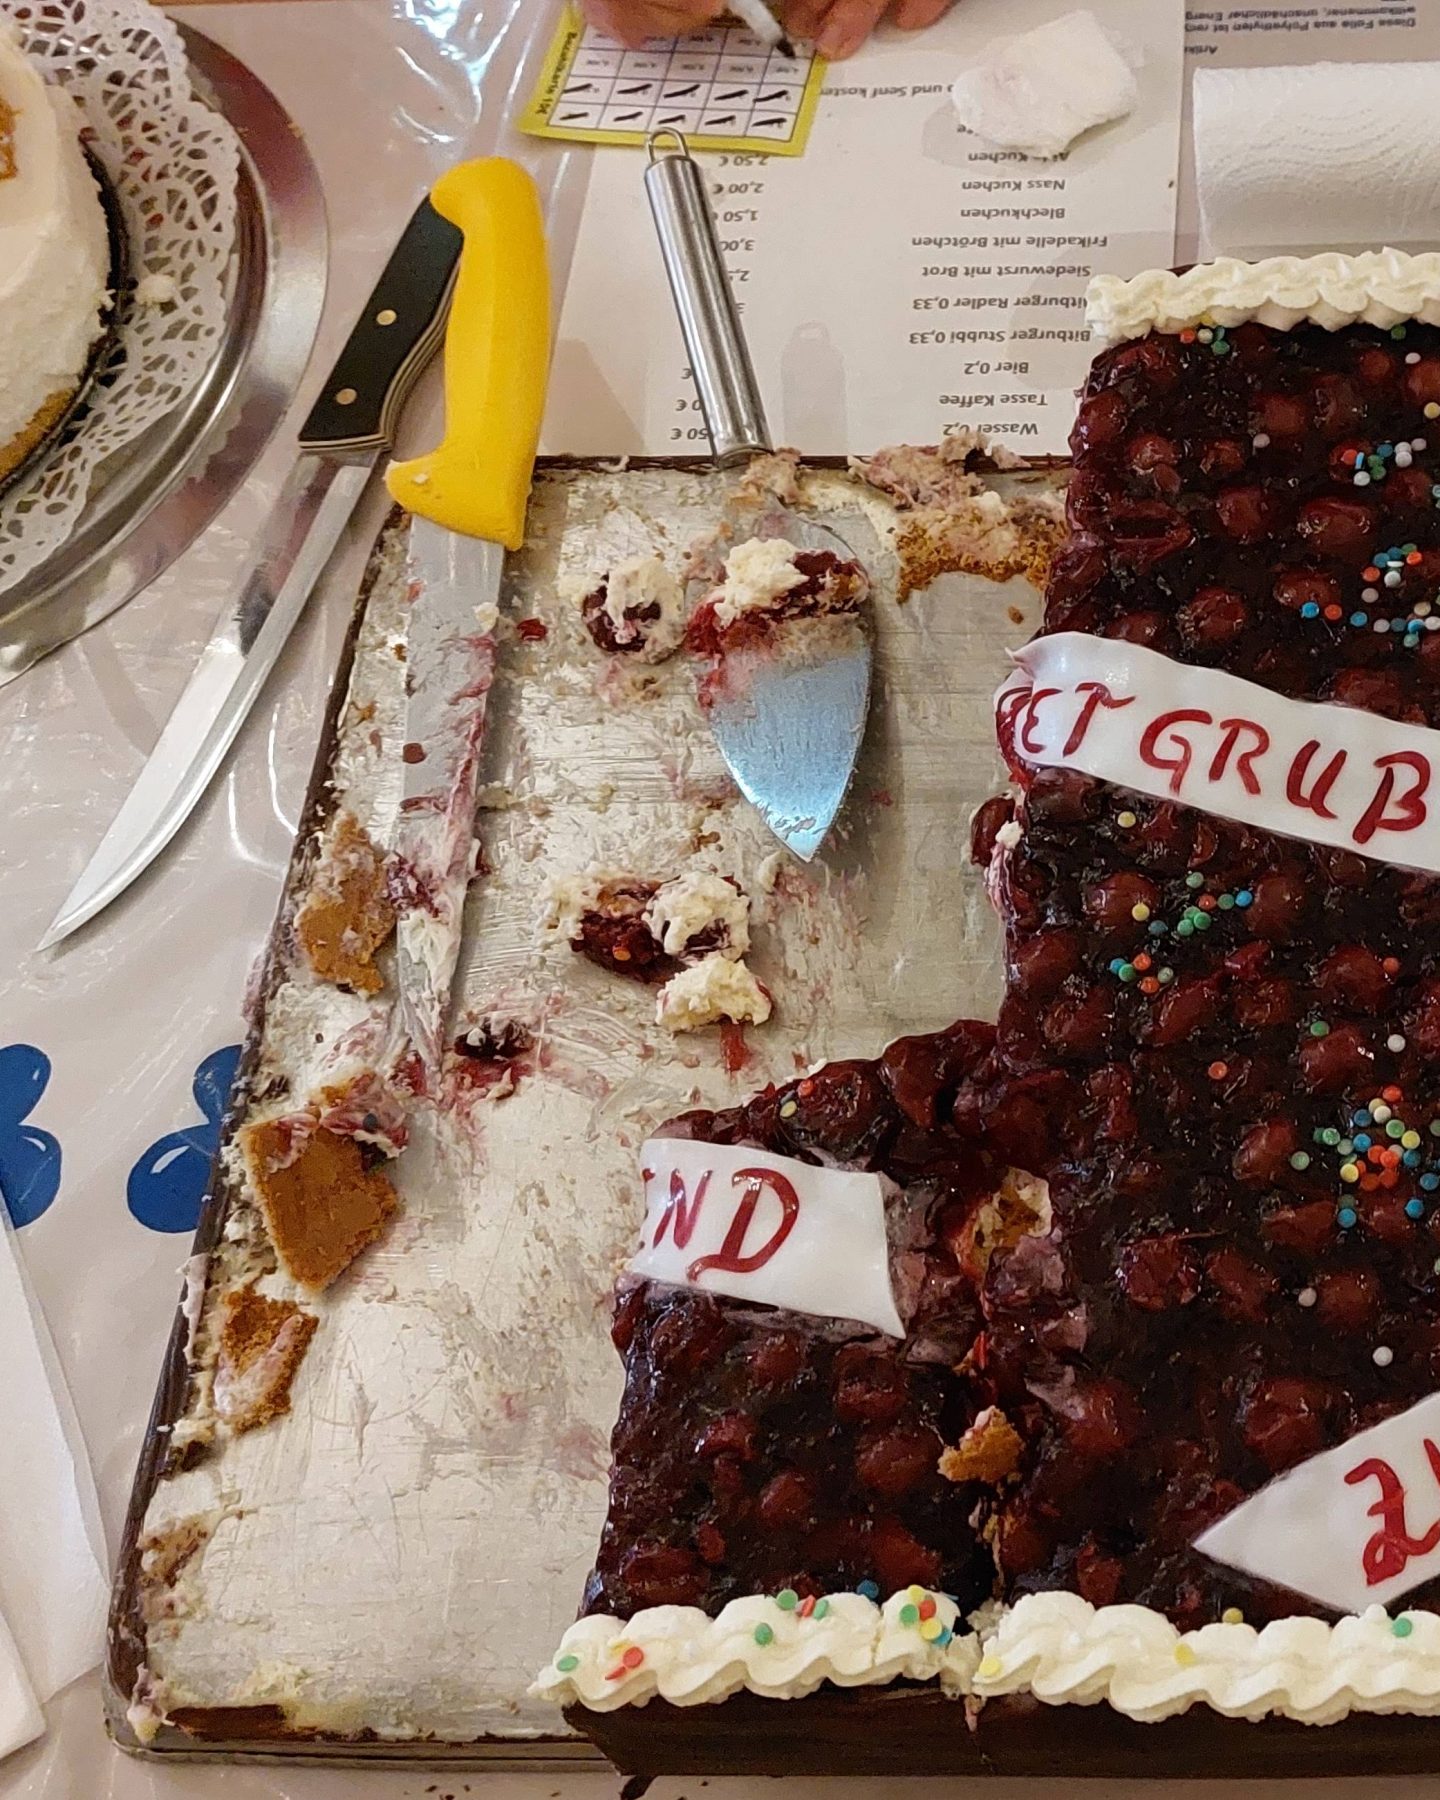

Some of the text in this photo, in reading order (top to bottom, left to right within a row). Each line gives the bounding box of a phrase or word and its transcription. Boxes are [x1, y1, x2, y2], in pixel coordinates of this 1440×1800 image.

[872, 86, 907, 98] Senf
[912, 84, 943, 97] und
[729, 182, 764, 195] 2,00
[962, 179, 1066, 192] Nass Kuchen
[724, 210, 758, 223] 1,50
[960, 208, 1066, 221] Blechkuchen
[912, 236, 1108, 249] Frikadelle mit Brötchen
[922, 265, 1091, 278] Siedewurst mit Brot
[913, 294, 1087, 310] itburger Radler 0,33
[909, 327, 1091, 344] Bitburger Stubbi 0,33
[964, 360, 1029, 375] Bier 0,2
[939, 393, 1048, 408] Tasse Kaffee
[642, 1167, 800, 1282] ND
